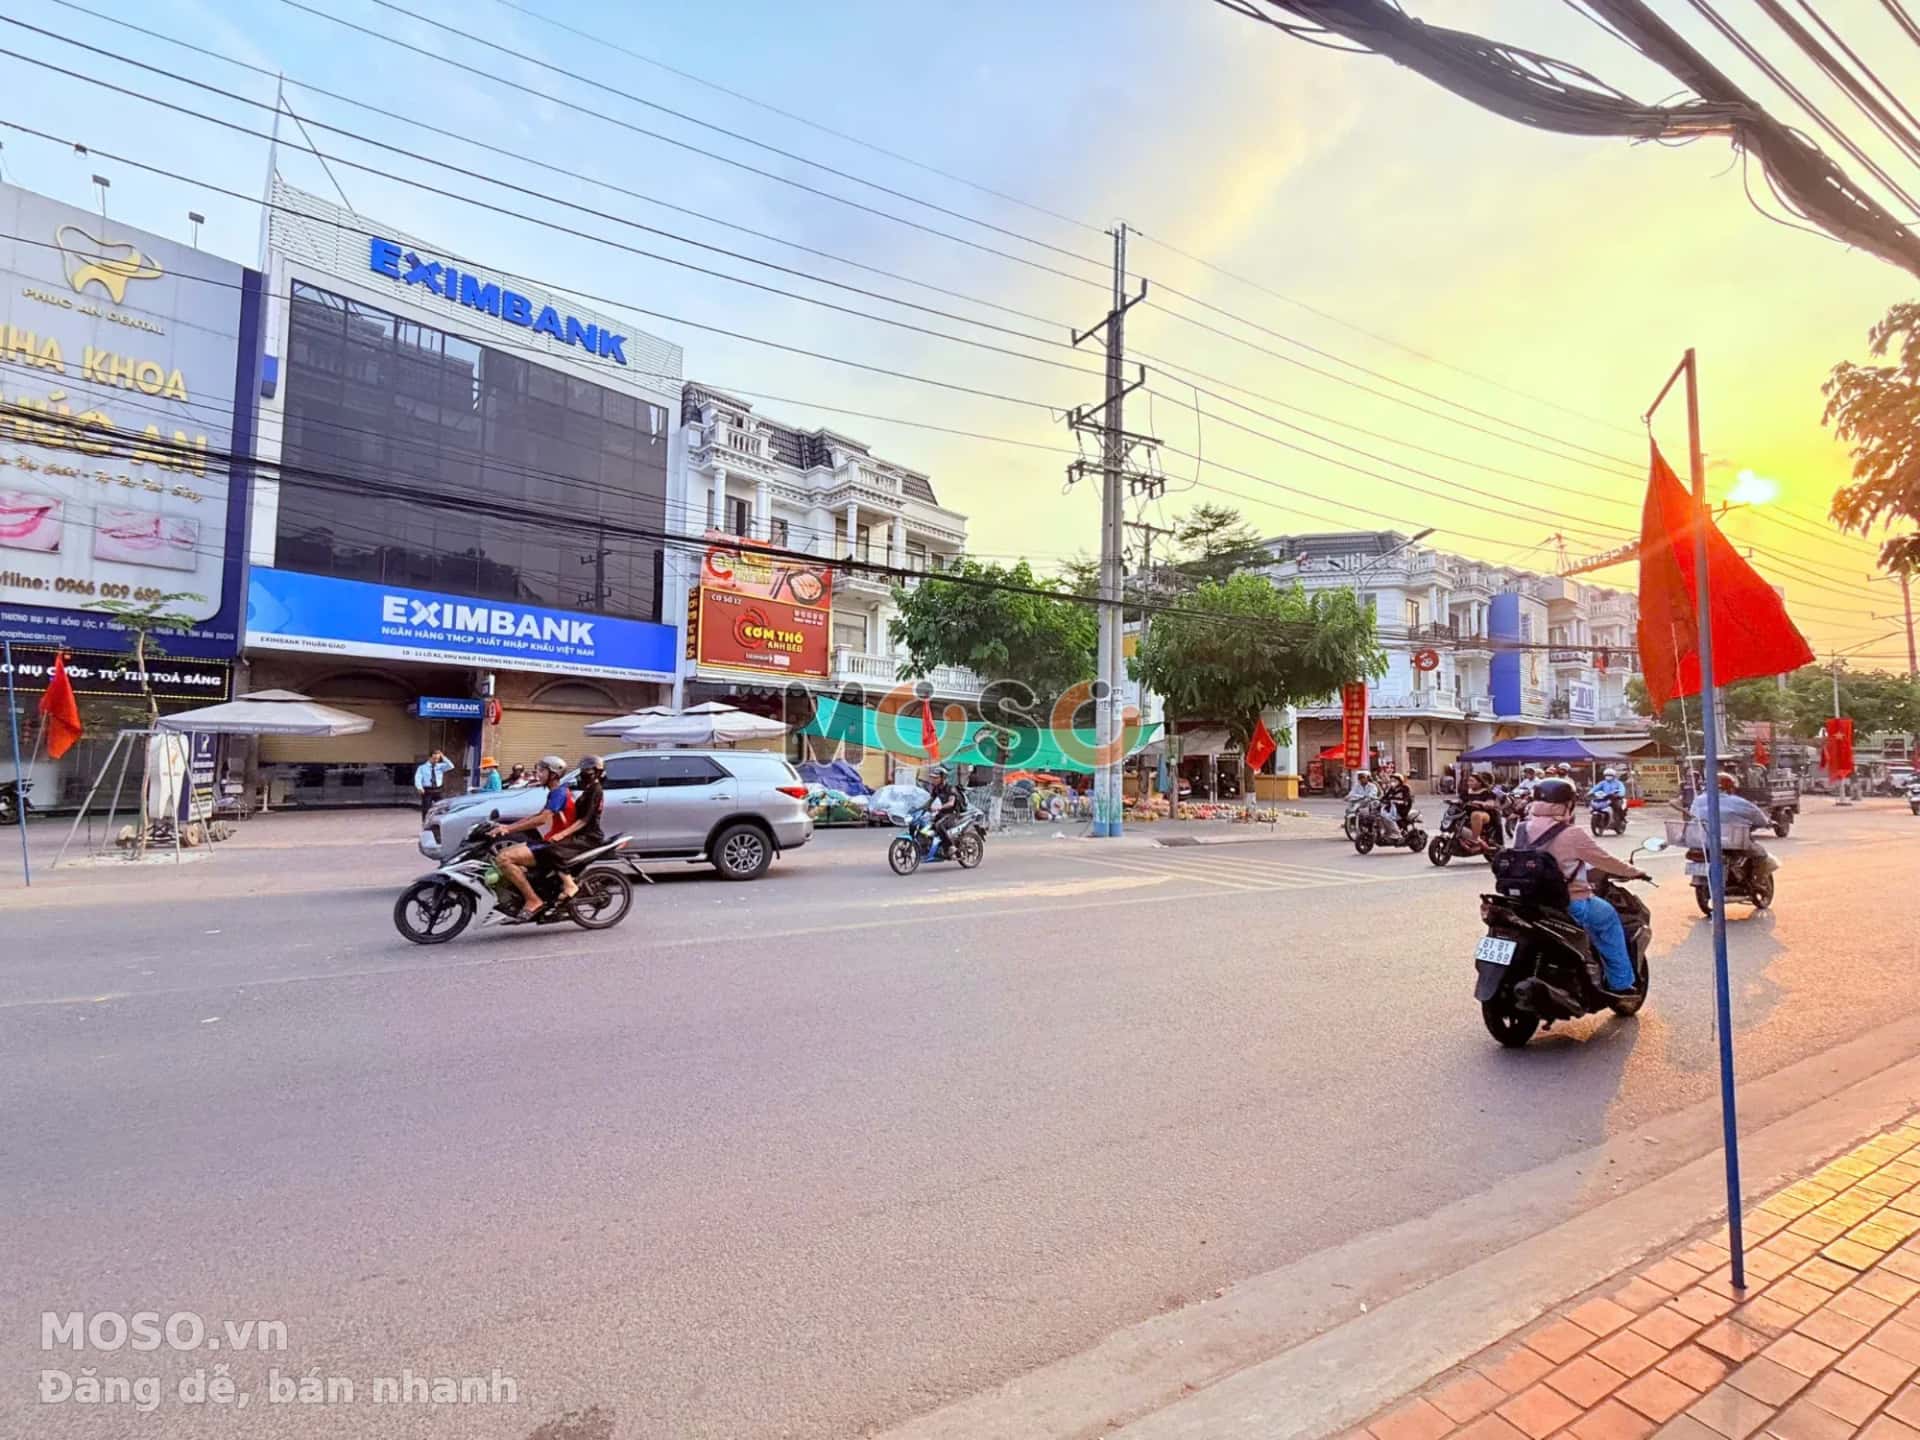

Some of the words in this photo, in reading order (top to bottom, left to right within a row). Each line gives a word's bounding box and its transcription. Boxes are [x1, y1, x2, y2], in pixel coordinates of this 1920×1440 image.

[370, 235, 628, 366] EXIMBANK
[83, 342, 189, 402] KHOA
[0, 570, 50, 591] tline:
[54, 577, 95, 595] 0966
[382, 594, 596, 647] EXIMBANK
[744, 626, 775, 640] CƠM
[381, 625, 412, 638] NGÂN
[414, 628, 445, 641] HÀNG
[447, 633, 474, 645] TMCP
[576, 648, 596, 657] NAM
[767, 641, 786, 651] ANH
[18, 664, 43, 677] NỤ
[183, 673, 222, 685] SÁNG
[426, 702, 480, 711] EXIMBANK
